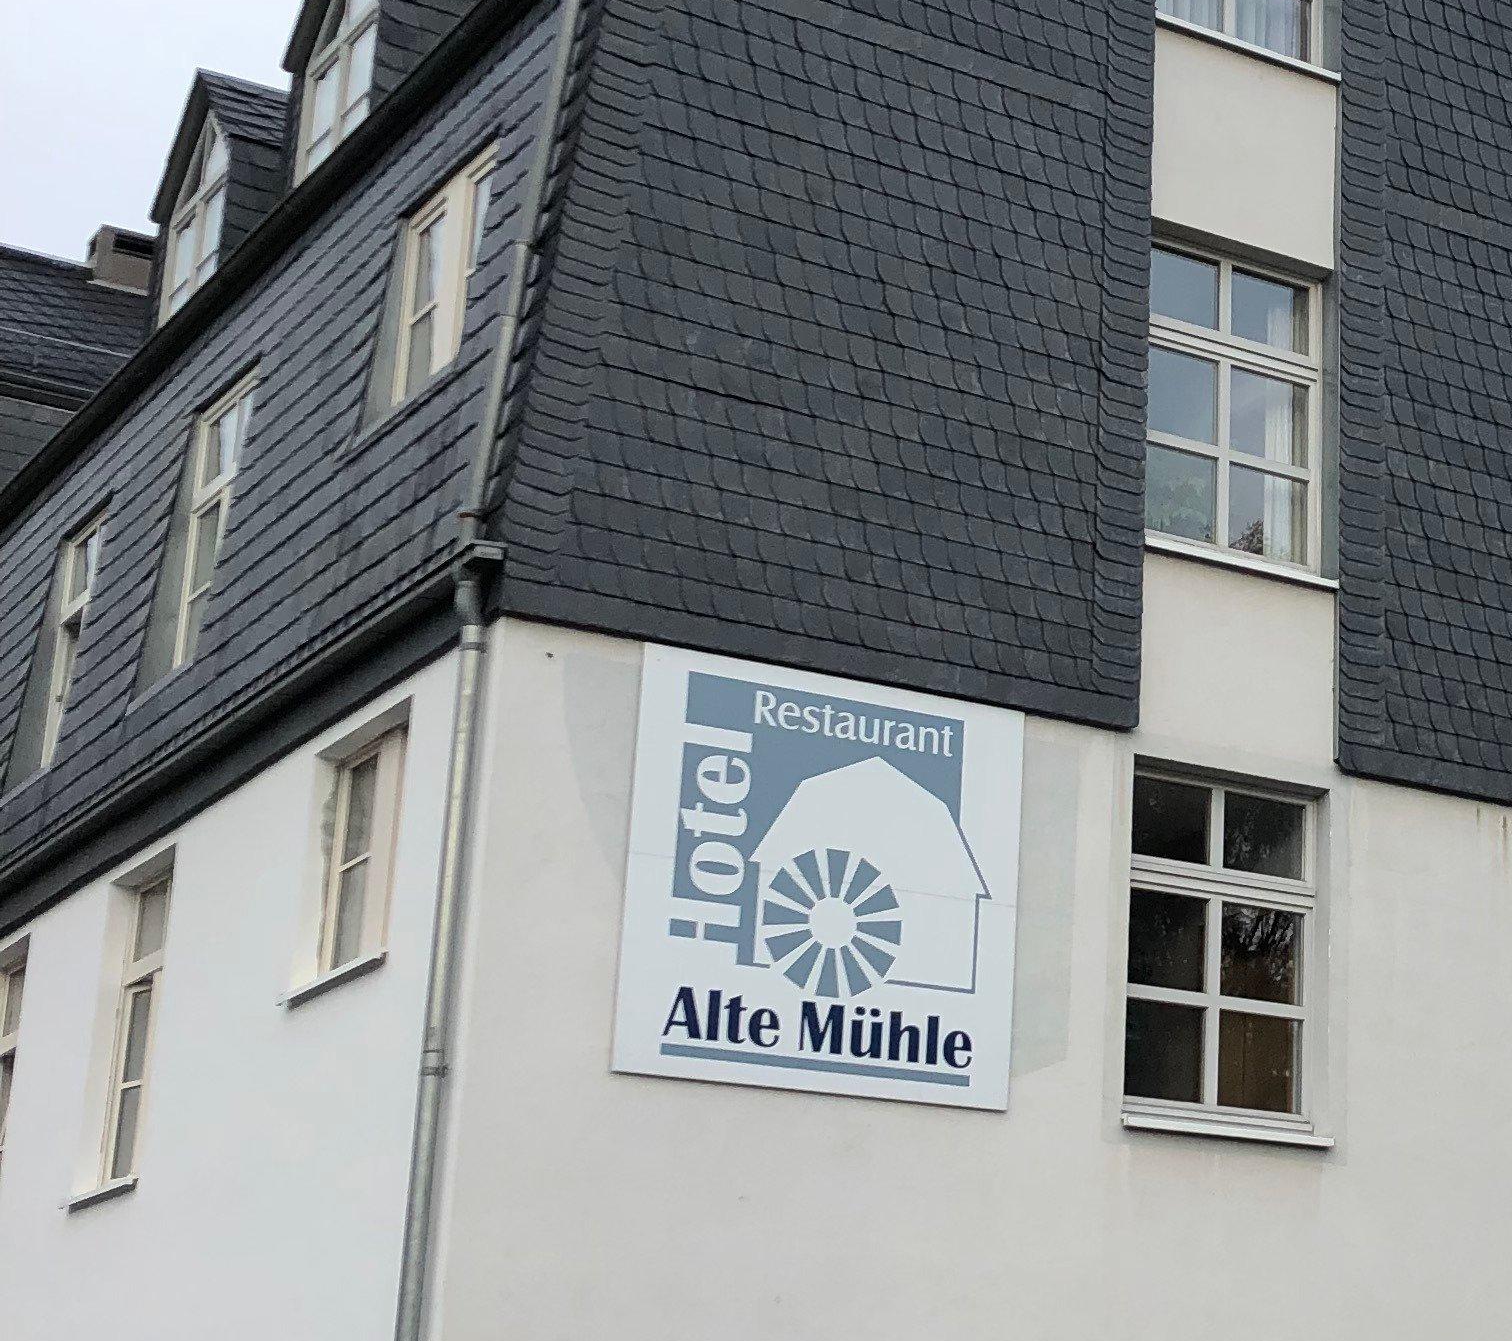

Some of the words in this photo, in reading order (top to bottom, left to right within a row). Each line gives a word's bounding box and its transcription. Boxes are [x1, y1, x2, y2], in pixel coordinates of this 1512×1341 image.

[754, 689, 954, 757] Restaurant
[671, 722, 753, 963] Hotel
[662, 986, 781, 1047] Alte
[799, 1000, 973, 1069] Mühle
